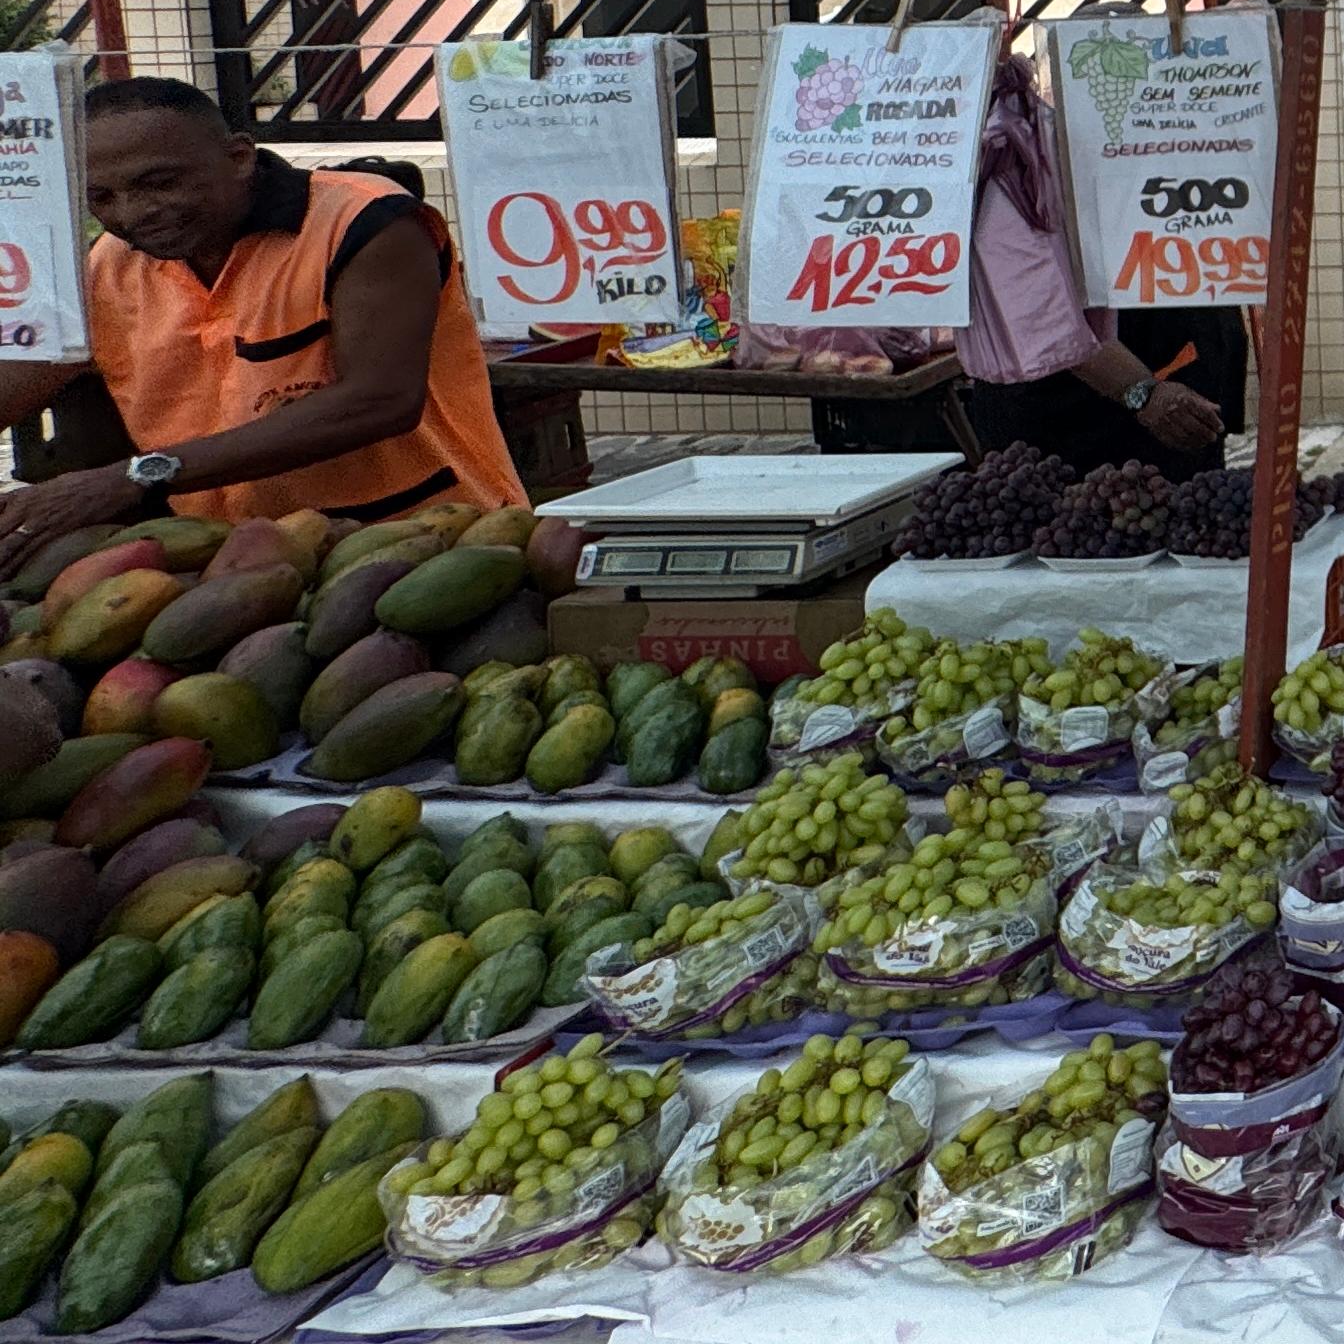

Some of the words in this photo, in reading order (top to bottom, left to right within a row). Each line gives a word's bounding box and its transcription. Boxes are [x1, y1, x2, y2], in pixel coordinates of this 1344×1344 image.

[584, 51, 637, 67] NORTE
[1160, 60, 1262, 83] THOMPSON
[877, 77, 962, 96] NIAGARA
[1141, 87, 1175, 101] SEM
[1189, 82, 1262, 100] SEMENTE
[468, 90, 632, 113] SELECIONADAS
[866, 98, 957, 122] ROSADA
[1131, 102, 1176, 113] SUPER
[1181, 101, 1218, 112] DOCE
[872, 131, 906, 144] BEM
[917, 130, 958, 144] DOCE
[1102, 137, 1254, 158] SELECIONADAS
[785, 149, 953, 167] SELECIONADAS
[815, 185, 932, 222] 500
[1140, 176, 1249, 218] 500
[846, 220, 915, 236] GRAMA
[1165, 212, 1233, 234] GRAMA
[486, 192, 667, 304] 9,99
[786, 232, 961, 312] 12,50
[1114, 230, 1271, 304] 19,99
[597, 273, 666, 304] KILO
[651, 639, 790, 662] PINHAS
